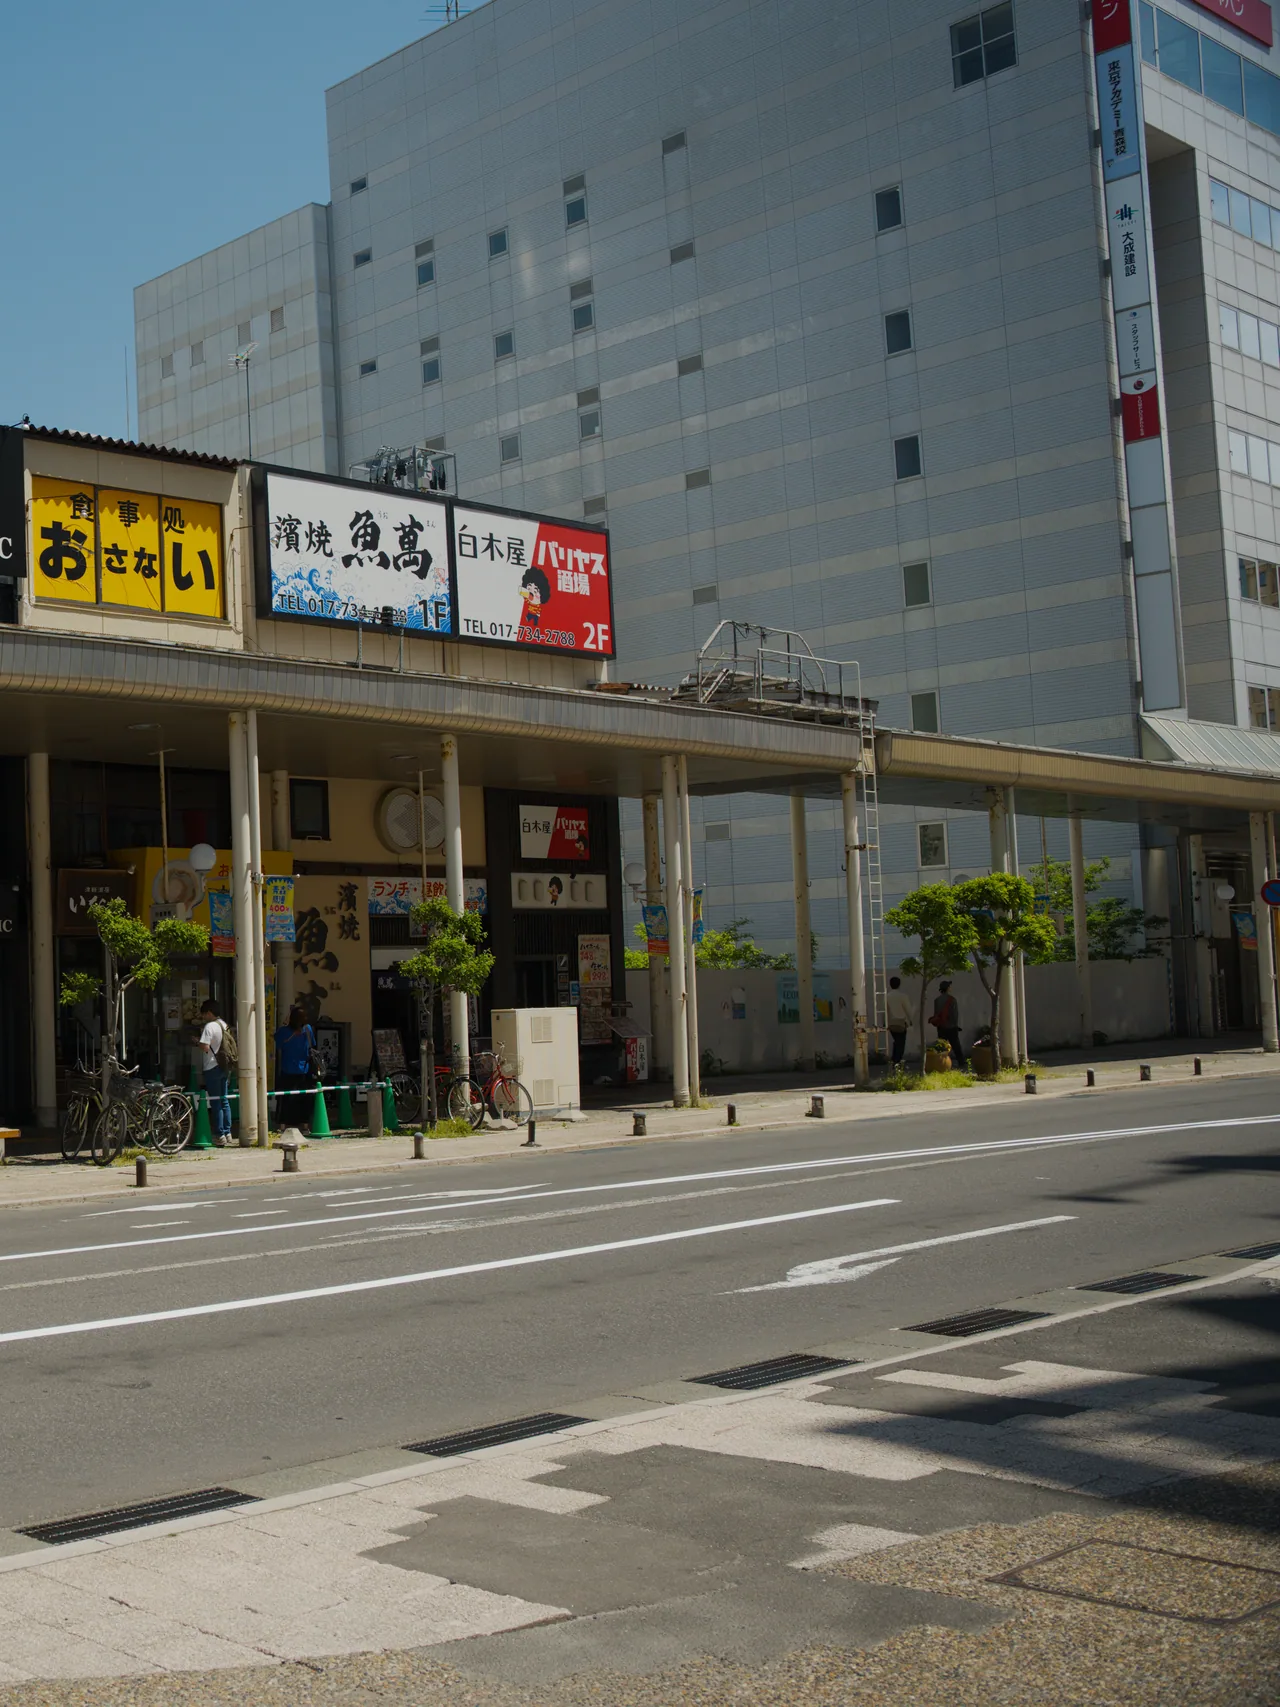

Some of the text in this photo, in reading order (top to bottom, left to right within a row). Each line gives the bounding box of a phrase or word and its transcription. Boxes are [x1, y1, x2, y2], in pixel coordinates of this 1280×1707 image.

[1107, 60, 1128, 156] 東京アカデミー青森校
[1122, 231, 1136, 277] 大成建設
[1131, 323, 1141, 370] スタッフサービス
[69, 491, 185, 535] 食事処
[39, 520, 216, 592] おさない
[342, 509, 433, 580] 魚萬
[458, 524, 528, 567] 白木屋
[537, 540, 607, 576] バリヤス
[557, 569, 591, 596] 酒場
[278, 594, 305, 611] TEL
[418, 599, 447, 629] 1F
[463, 618, 576, 647] TEL 017-734-2788
[582, 621, 609, 650] 2F
[522, 818, 551, 834] 白木屋
[373, 881, 448, 897] ランチ・昼飲
[337, 881, 360, 941] 濱焼
